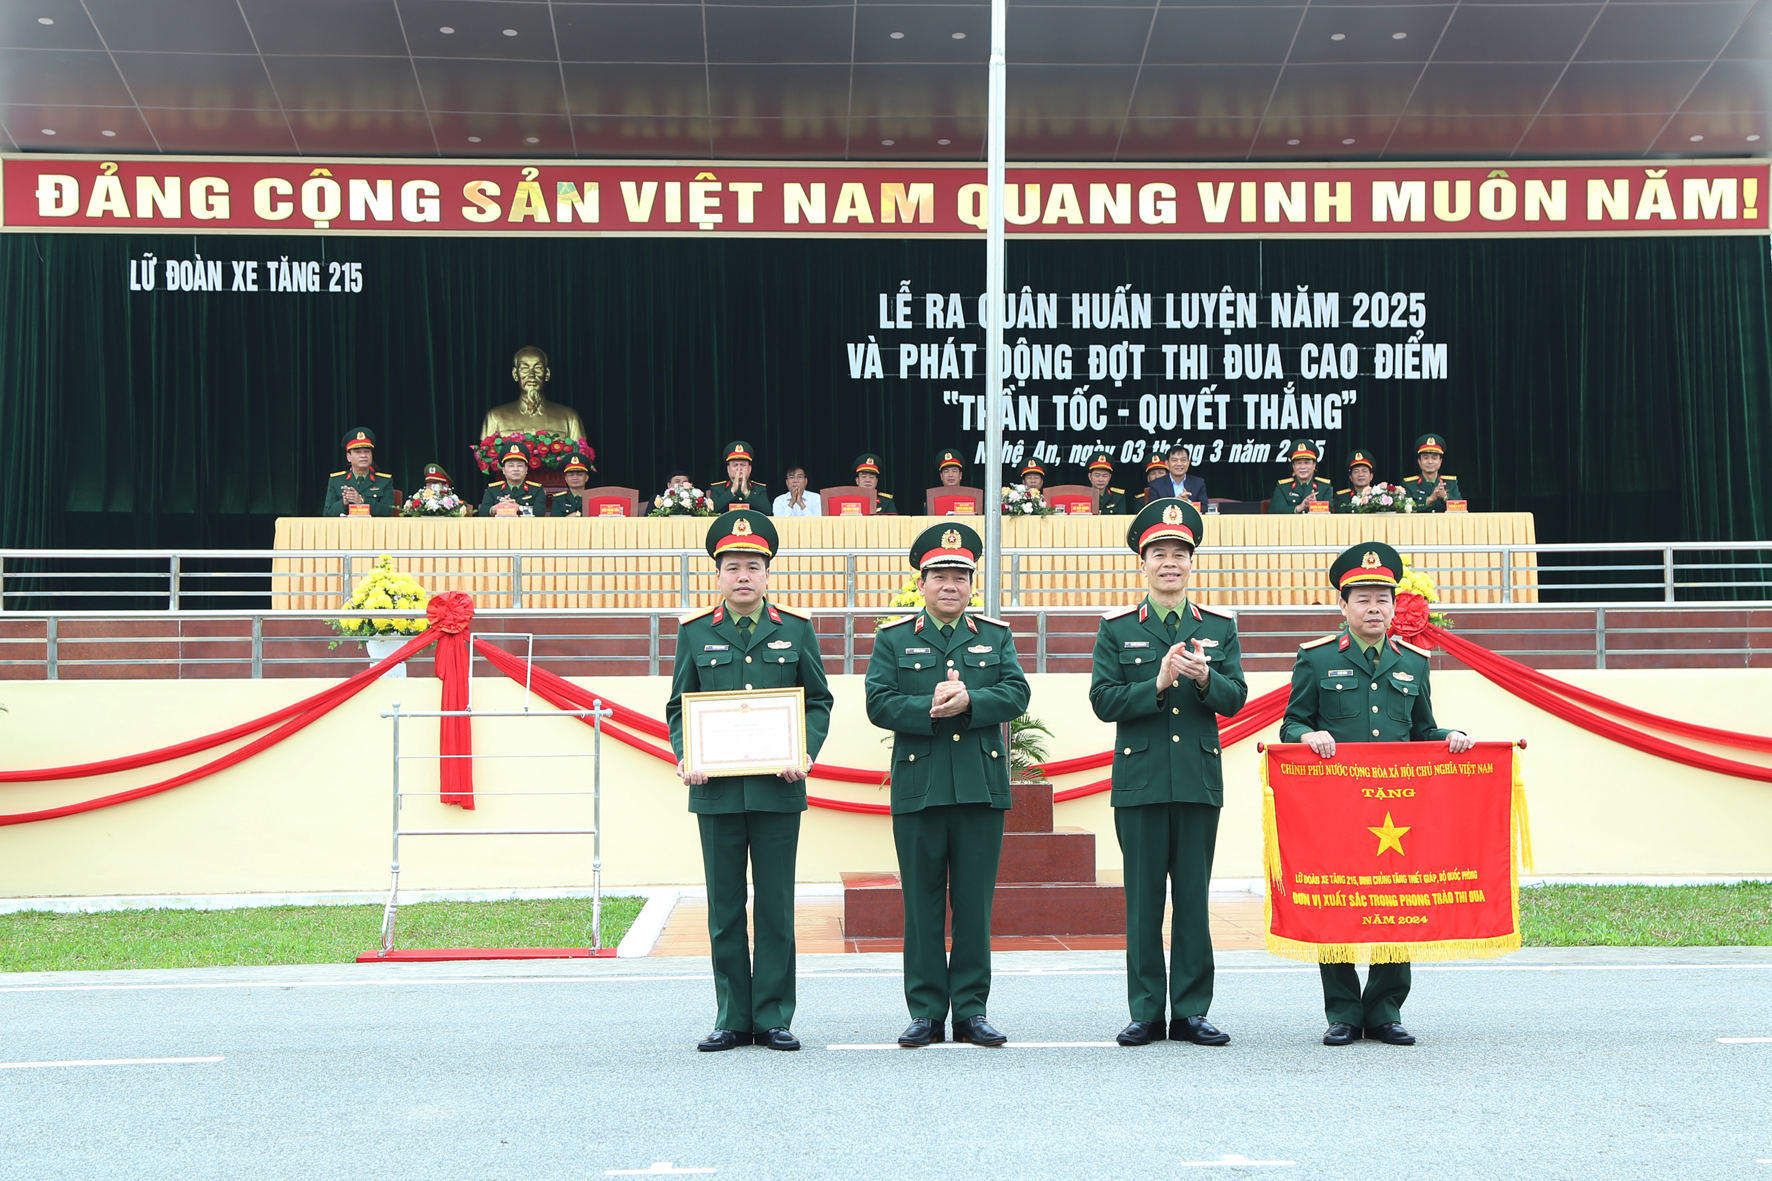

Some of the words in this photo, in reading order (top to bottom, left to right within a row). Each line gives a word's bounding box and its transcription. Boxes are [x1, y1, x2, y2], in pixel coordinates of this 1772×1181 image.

[35, 161, 231, 220] ĐẢNG
[253, 168, 441, 229] CỘNG
[461, 167, 601, 223] SẢN
[619, 172, 763, 230] VIỆT
[783, 182, 935, 224] NAM
[957, 182, 1177, 230] QUANG
[1196, 181, 1352, 223] VINH
[1371, 169, 1567, 222] MUÔN
[1586, 169, 1758, 221] NĂM!
[130, 252, 157, 291] LỮ
[166, 254, 222, 292] ĐOÀN
[231, 260, 258, 292] XE
[267, 255, 320, 293] TĂNG
[328, 261, 363, 293] 215
[879, 279, 913, 329] LỄ
[925, 293, 966, 329] RA
[1072, 284, 1152, 329] HUẤN
[1165, 285, 1257, 335] LUYỆN
[1271, 285, 1339, 328] NĂM
[1352, 291, 1427, 328] 2025
[847, 335, 884, 379] VÀ
[900, 337, 977, 379] PHÁT
[1088, 341, 1145, 387] ĐỢT
[1162, 344, 1208, 380] THI
[1223, 344, 1284, 380] ĐUA
[1300, 343, 1358, 379] CAO
[1374, 329, 1448, 379] ĐIỂM
[1053, 384, 1108, 431] TỐC
[1118, 408, 1130, 417] -
[1139, 384, 1231, 434] QUYẾT
[974, 439, 1025, 468] Nhệ
[1033, 440, 1061, 467] An,
[1120, 439, 1147, 463] 03
[1209, 439, 1224, 463] 3
[1228, 438, 1271, 463] năm
[1275, 439, 1327, 463] 25
[1281, 762, 1306, 776] CHÍNH
[1308, 761, 1324, 776] PHỦ
[1326, 762, 1348, 776] NƯỚC
[1349, 763, 1370, 780] CỘNG
[1372, 765, 1388, 778] HÒA
[1388, 764, 1399, 778] XÃ
[1400, 763, 1415, 780] HỘI
[1416, 761, 1432, 777] CHỦ
[1434, 761, 1457, 775] NGHĨA
[1458, 761, 1476, 777] VIỆT
[1477, 763, 1494, 774] NAM
[1362, 787, 1416, 800] TẶNG
[1321, 875, 1329, 884] XE
[1330, 872, 1345, 884] TĂNG
[1392, 872, 1407, 884] TĂNG
[1292, 892, 1311, 906] ĐƠN
[1312, 894, 1322, 909] VỊ
[1323, 890, 1346, 907] XUẤT
[1349, 891, 1367, 907] SẮC
[1368, 894, 1399, 907] TRONG
[1399, 894, 1431, 907] PHONG
[1432, 890, 1454, 905] TRÀO
[1454, 891, 1468, 903] THI
[1468, 890, 1485, 903] ĐUA
[1362, 914, 1396, 925] NĂM
[1398, 916, 1428, 925] 2024
